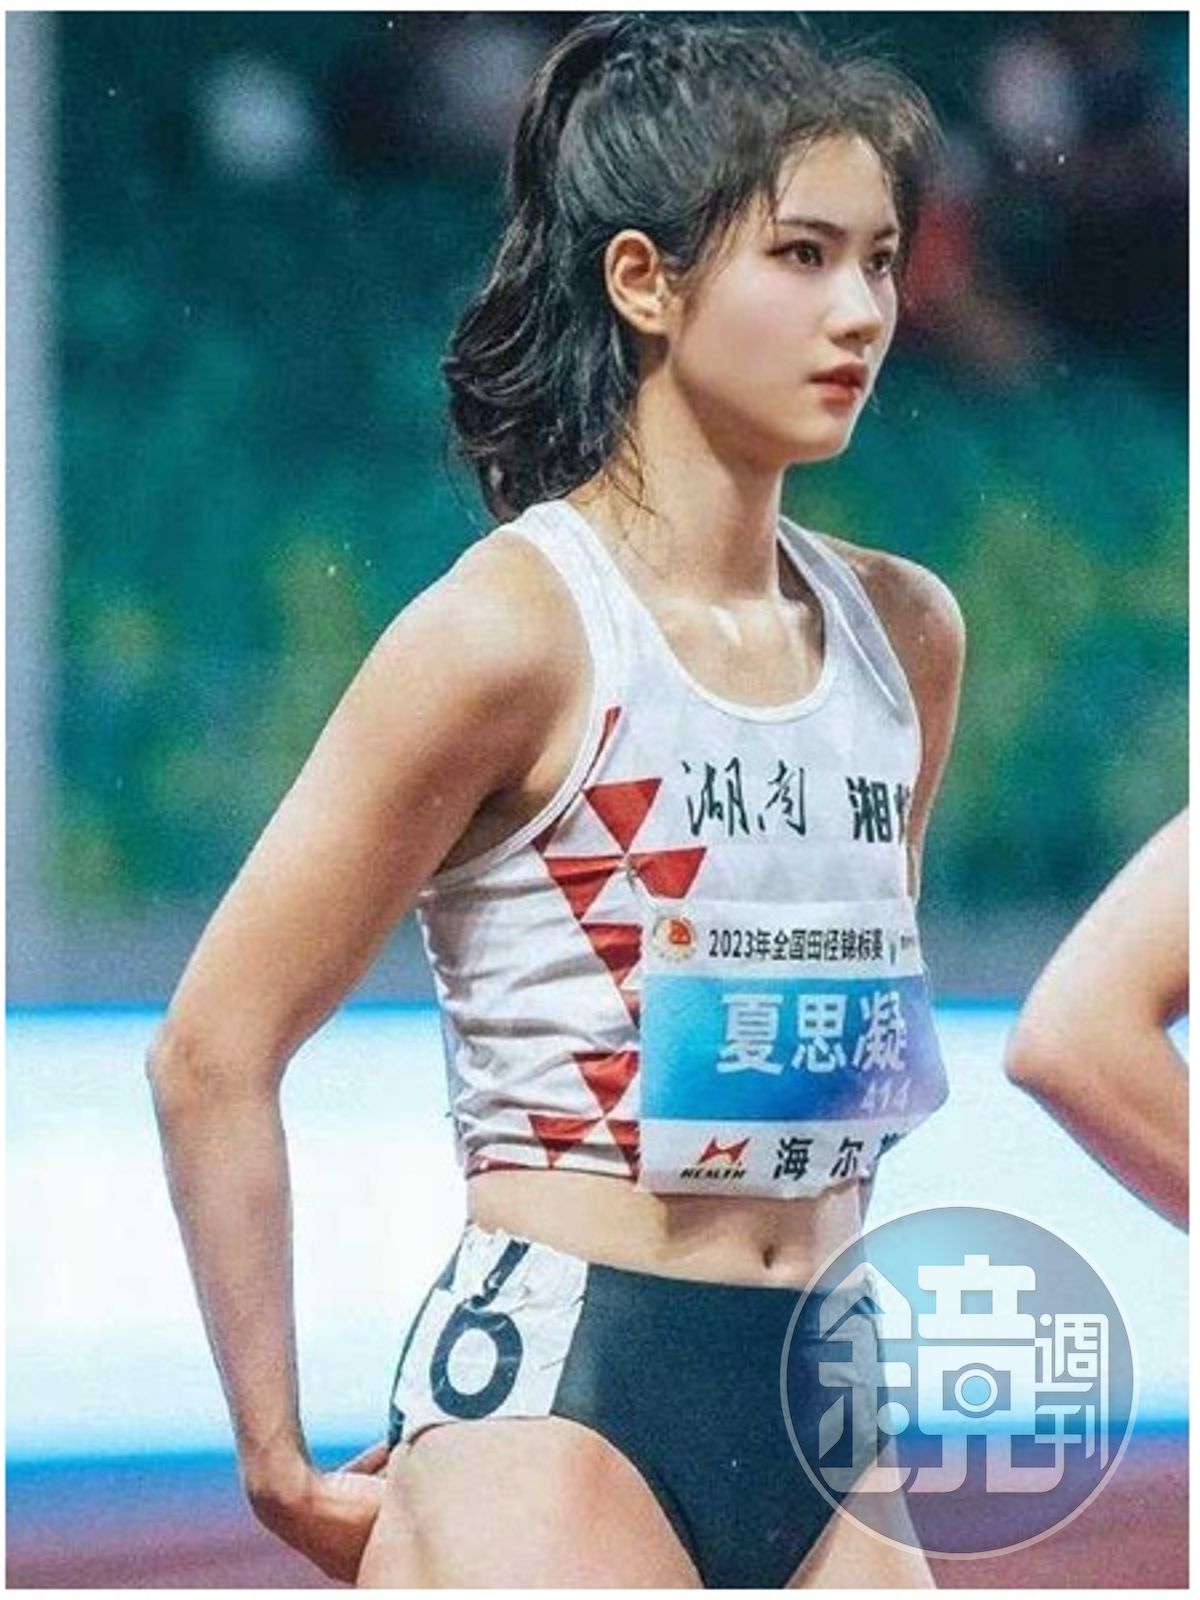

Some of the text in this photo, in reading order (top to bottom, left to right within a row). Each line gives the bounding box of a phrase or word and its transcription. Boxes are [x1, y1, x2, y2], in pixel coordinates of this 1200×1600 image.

[716, 990, 906, 1076] 夏思凝
[429, 1240, 532, 1419] 6
